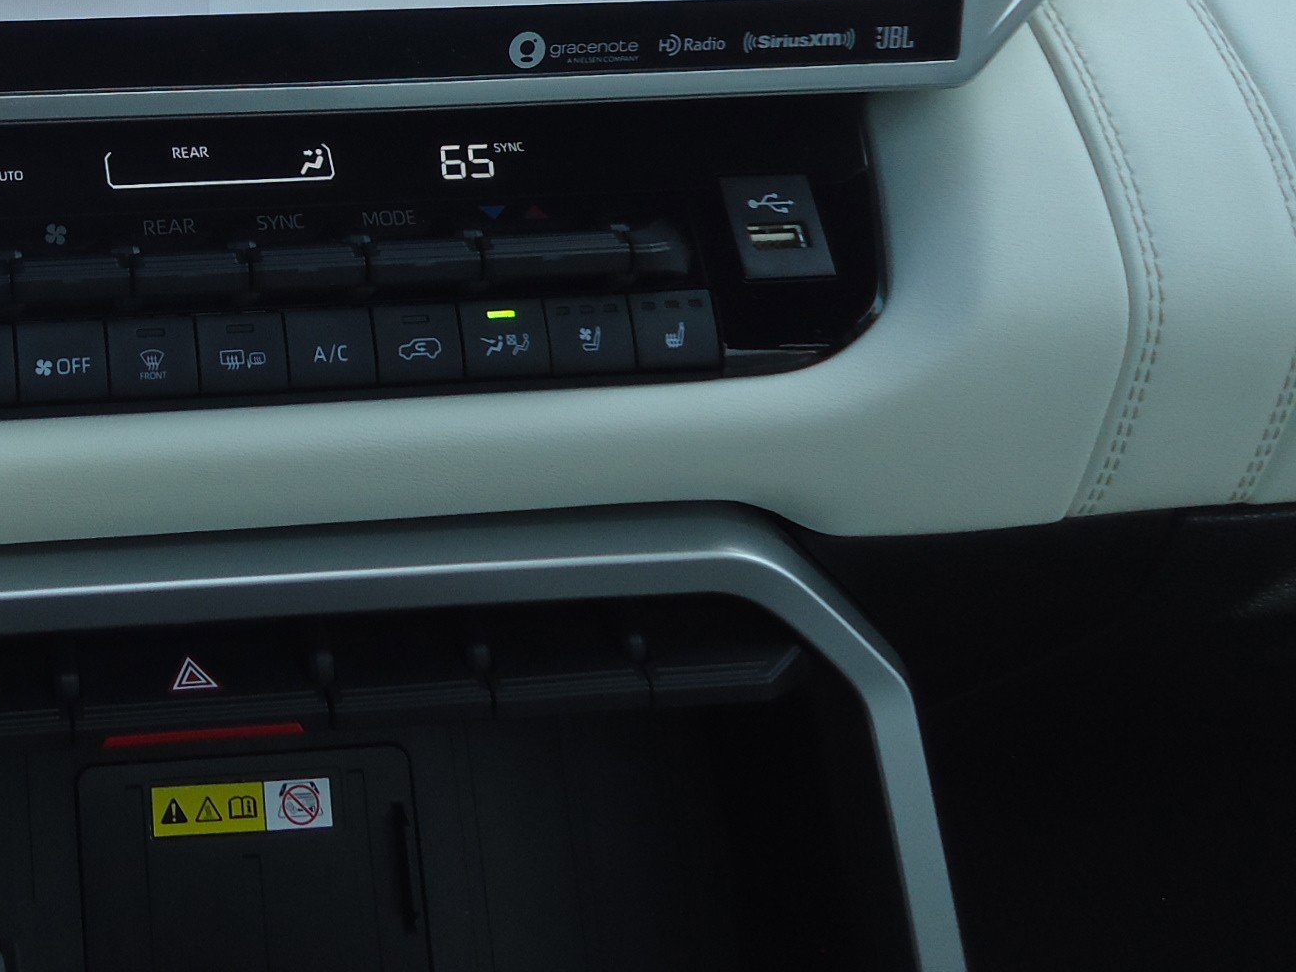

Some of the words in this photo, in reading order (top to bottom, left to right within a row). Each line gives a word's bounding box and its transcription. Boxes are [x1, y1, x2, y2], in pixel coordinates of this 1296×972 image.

[685, 37, 726, 52] Radio
[877, 26, 914, 50] JBL
[550, 39, 639, 57] gracenote
[172, 147, 209, 160] REAR
[494, 143, 525, 154] SYNC
[440, 144, 494, 180] 65
[256, 214, 304, 230] SYNC
[362, 209, 416, 227] MODE
[143, 219, 195, 237] REAR
[314, 344, 348, 363] A/C
[56, 357, 91, 375] OFF
[140, 370, 166, 380] FRONT
